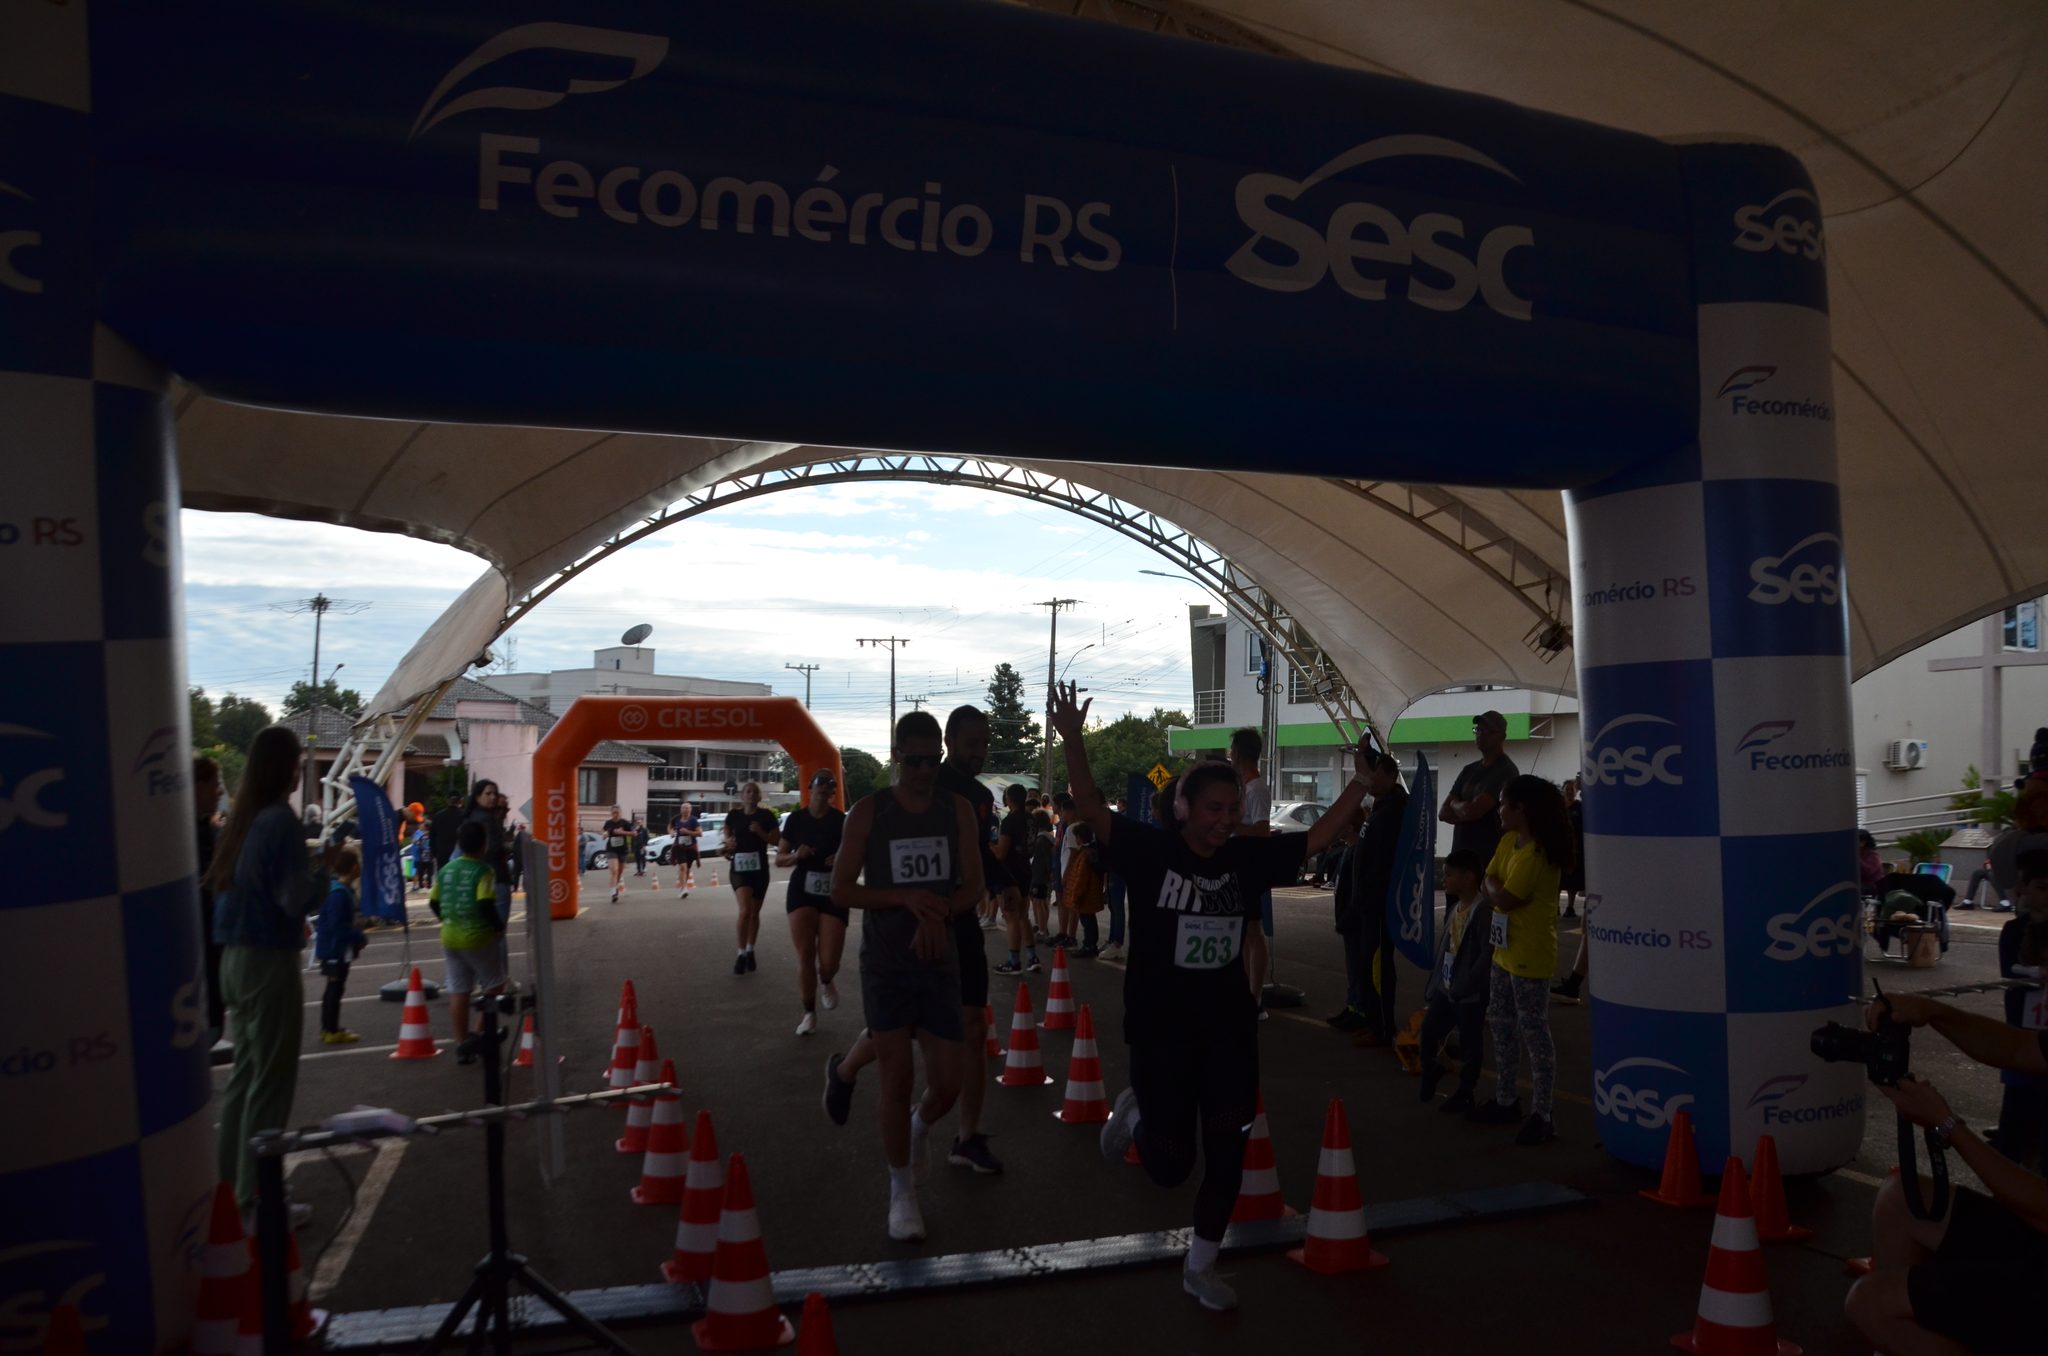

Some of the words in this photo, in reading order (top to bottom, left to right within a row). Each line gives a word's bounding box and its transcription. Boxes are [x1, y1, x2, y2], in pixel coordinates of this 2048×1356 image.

[478, 132, 993, 257] Fecomércio
[1019, 194, 1123, 271] RS
[1224, 172, 1533, 321] Sesc
[1733, 204, 1824, 261] Ses
[33, 517, 83, 546] RS
[1663, 577, 1697, 597] RS
[1747, 556, 1842, 606] Ses
[657, 707, 763, 728] CRESOL
[547, 781, 567, 872] CRESOL
[900, 853, 942, 878] 501
[1183, 936, 1232, 963] 263
[1679, 930, 1713, 950] RS
[67, 1030, 118, 1067] RS
